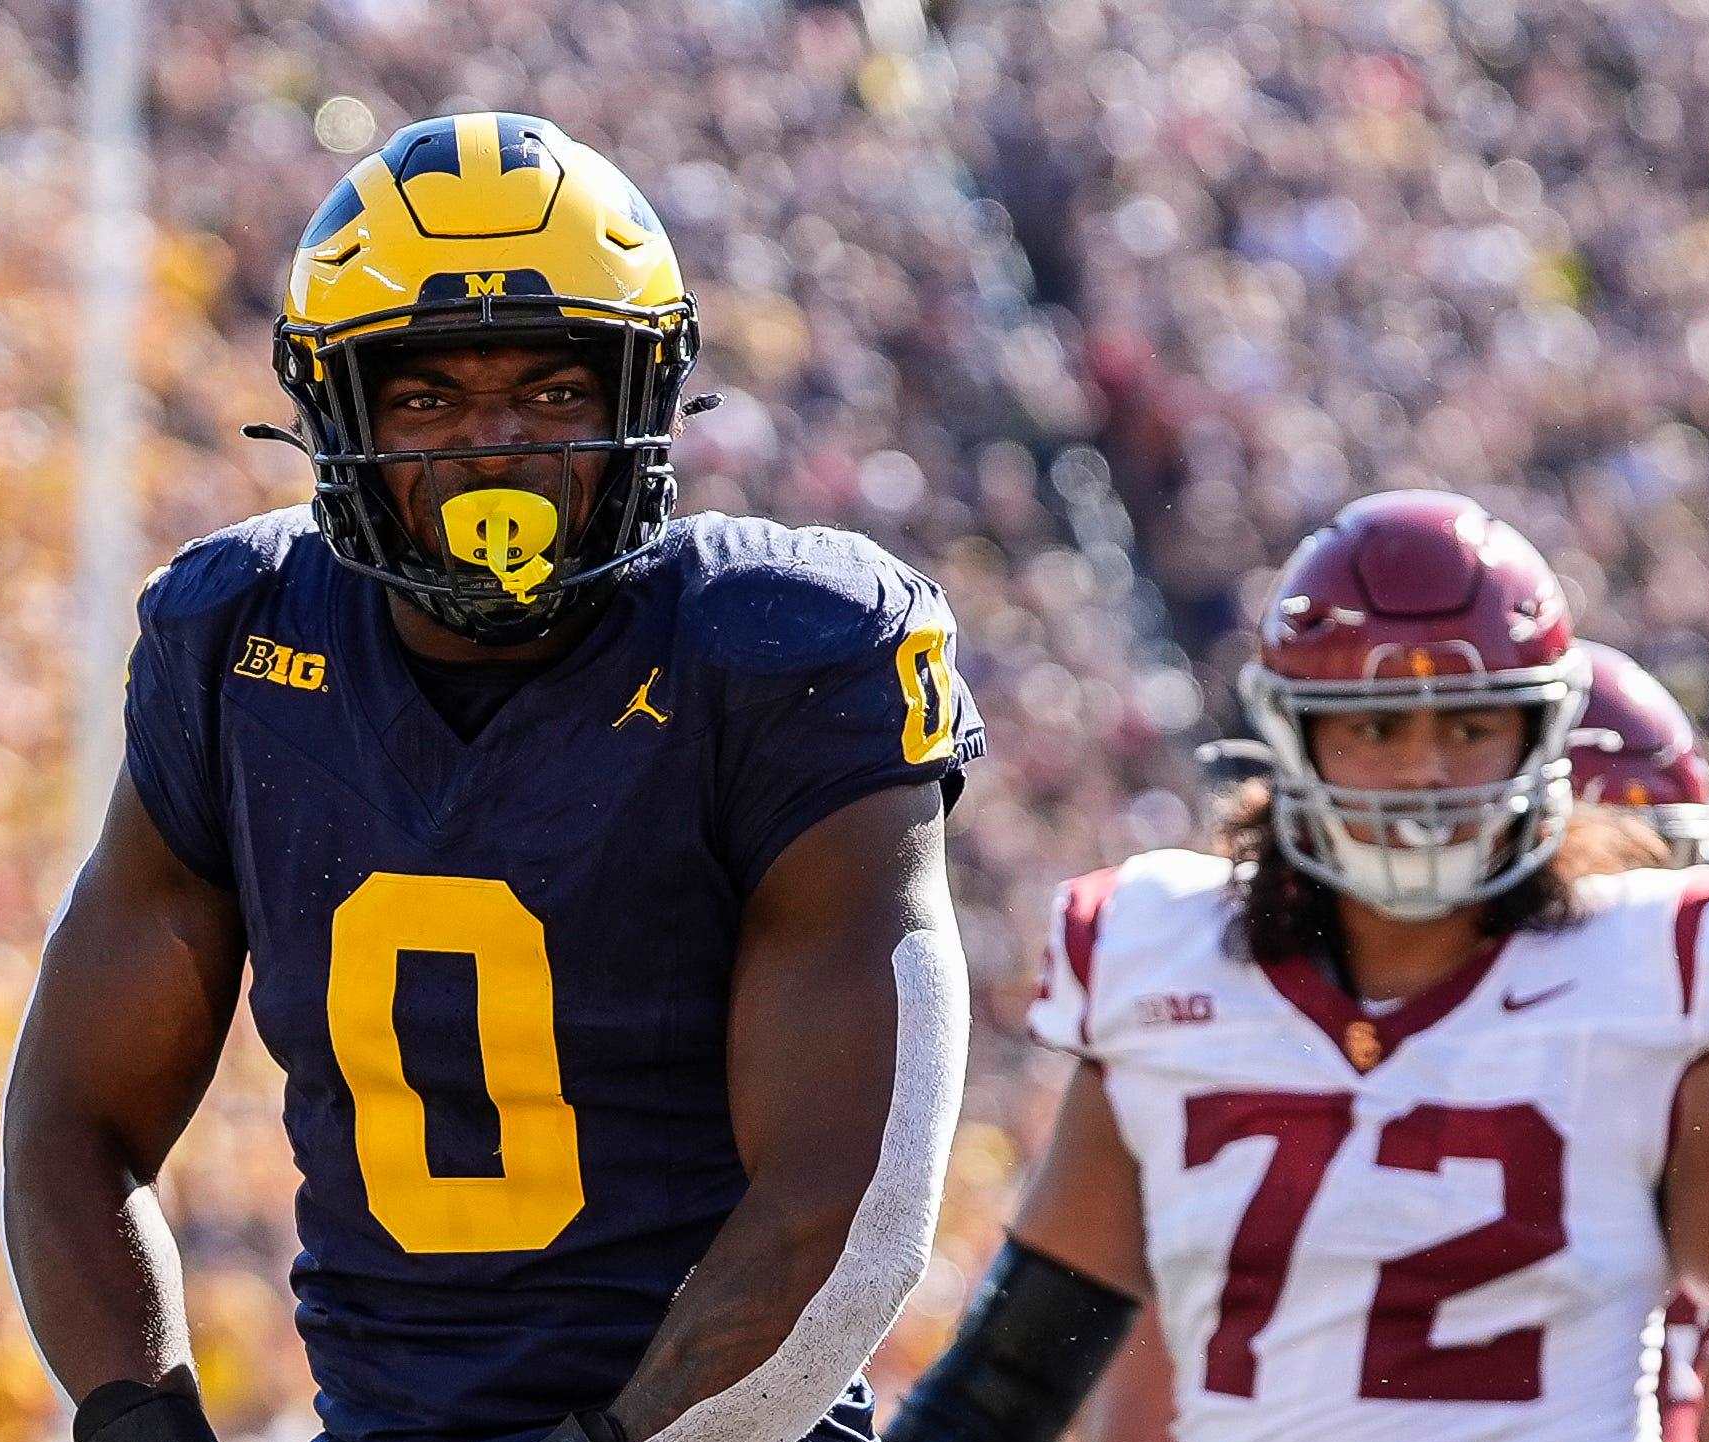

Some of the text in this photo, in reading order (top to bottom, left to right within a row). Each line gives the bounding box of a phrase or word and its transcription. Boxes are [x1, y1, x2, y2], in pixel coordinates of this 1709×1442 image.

[464, 272, 507, 298] M
[895, 624, 953, 765] 0
[327, 871, 586, 1254] 0
[1184, 1089, 1569, 1401] 72
